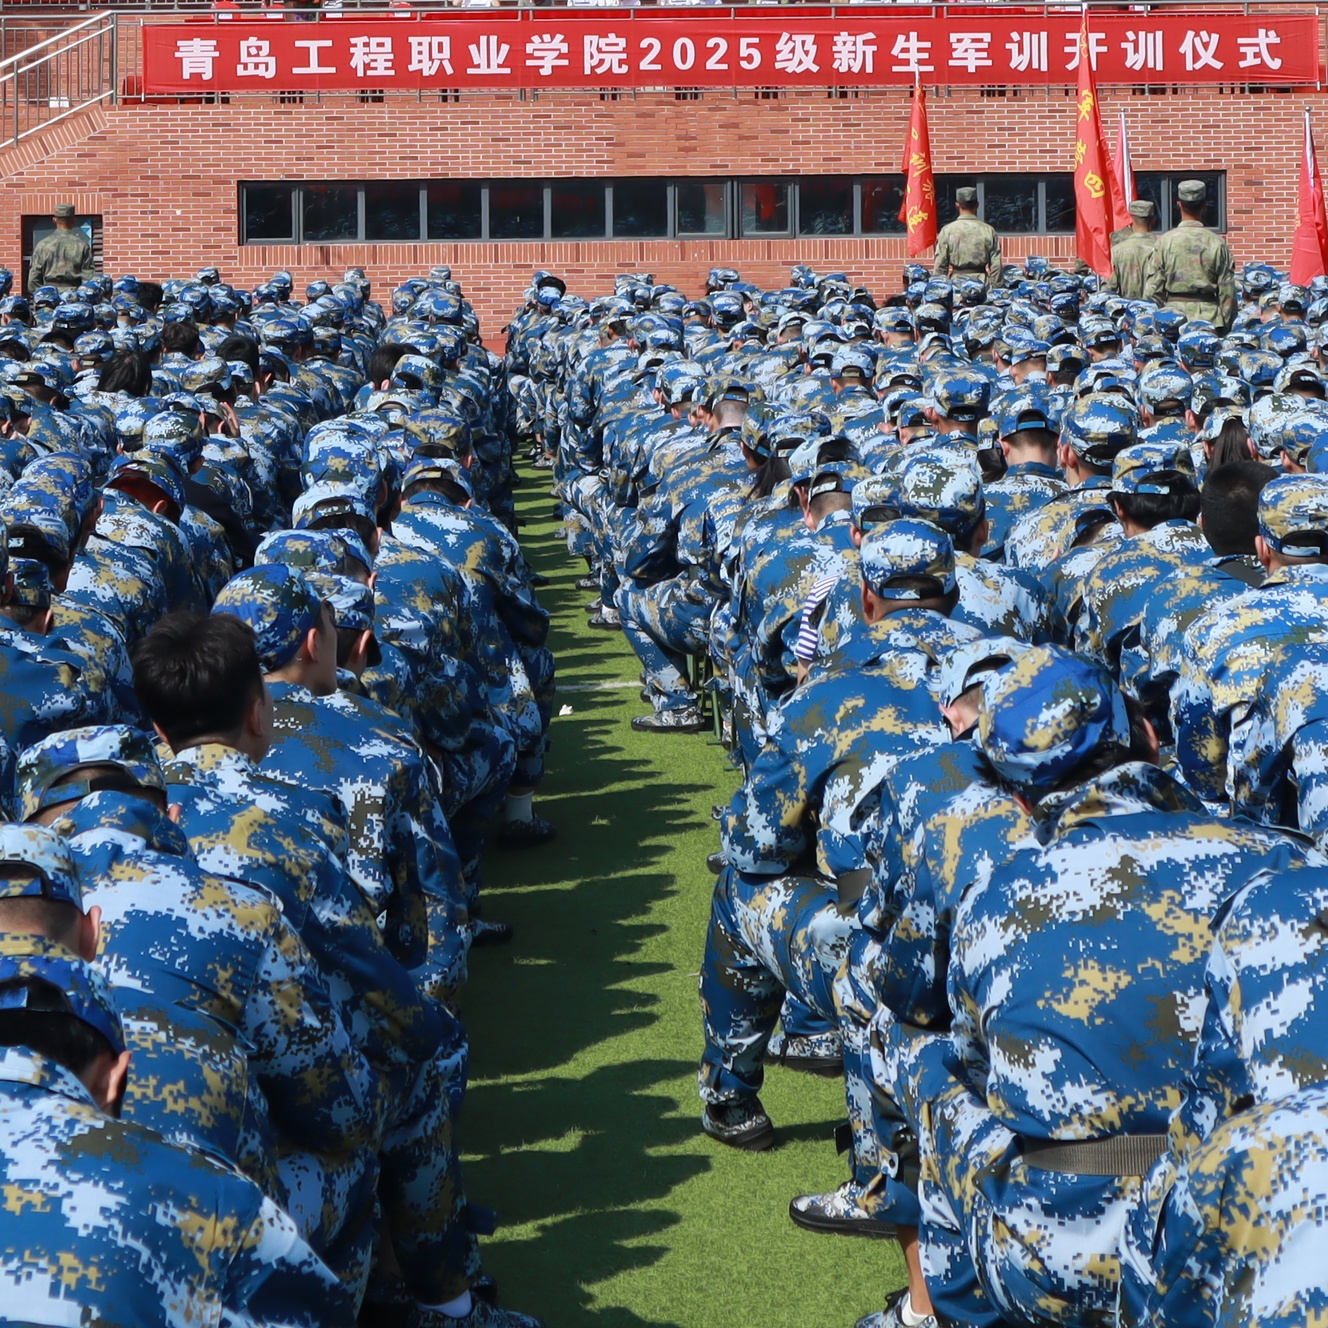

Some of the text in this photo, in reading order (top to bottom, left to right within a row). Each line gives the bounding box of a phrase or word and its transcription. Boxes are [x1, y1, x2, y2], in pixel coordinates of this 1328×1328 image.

[173, 28, 1283, 81] 青岛工程职业学院2025级新生军训开训仪式
